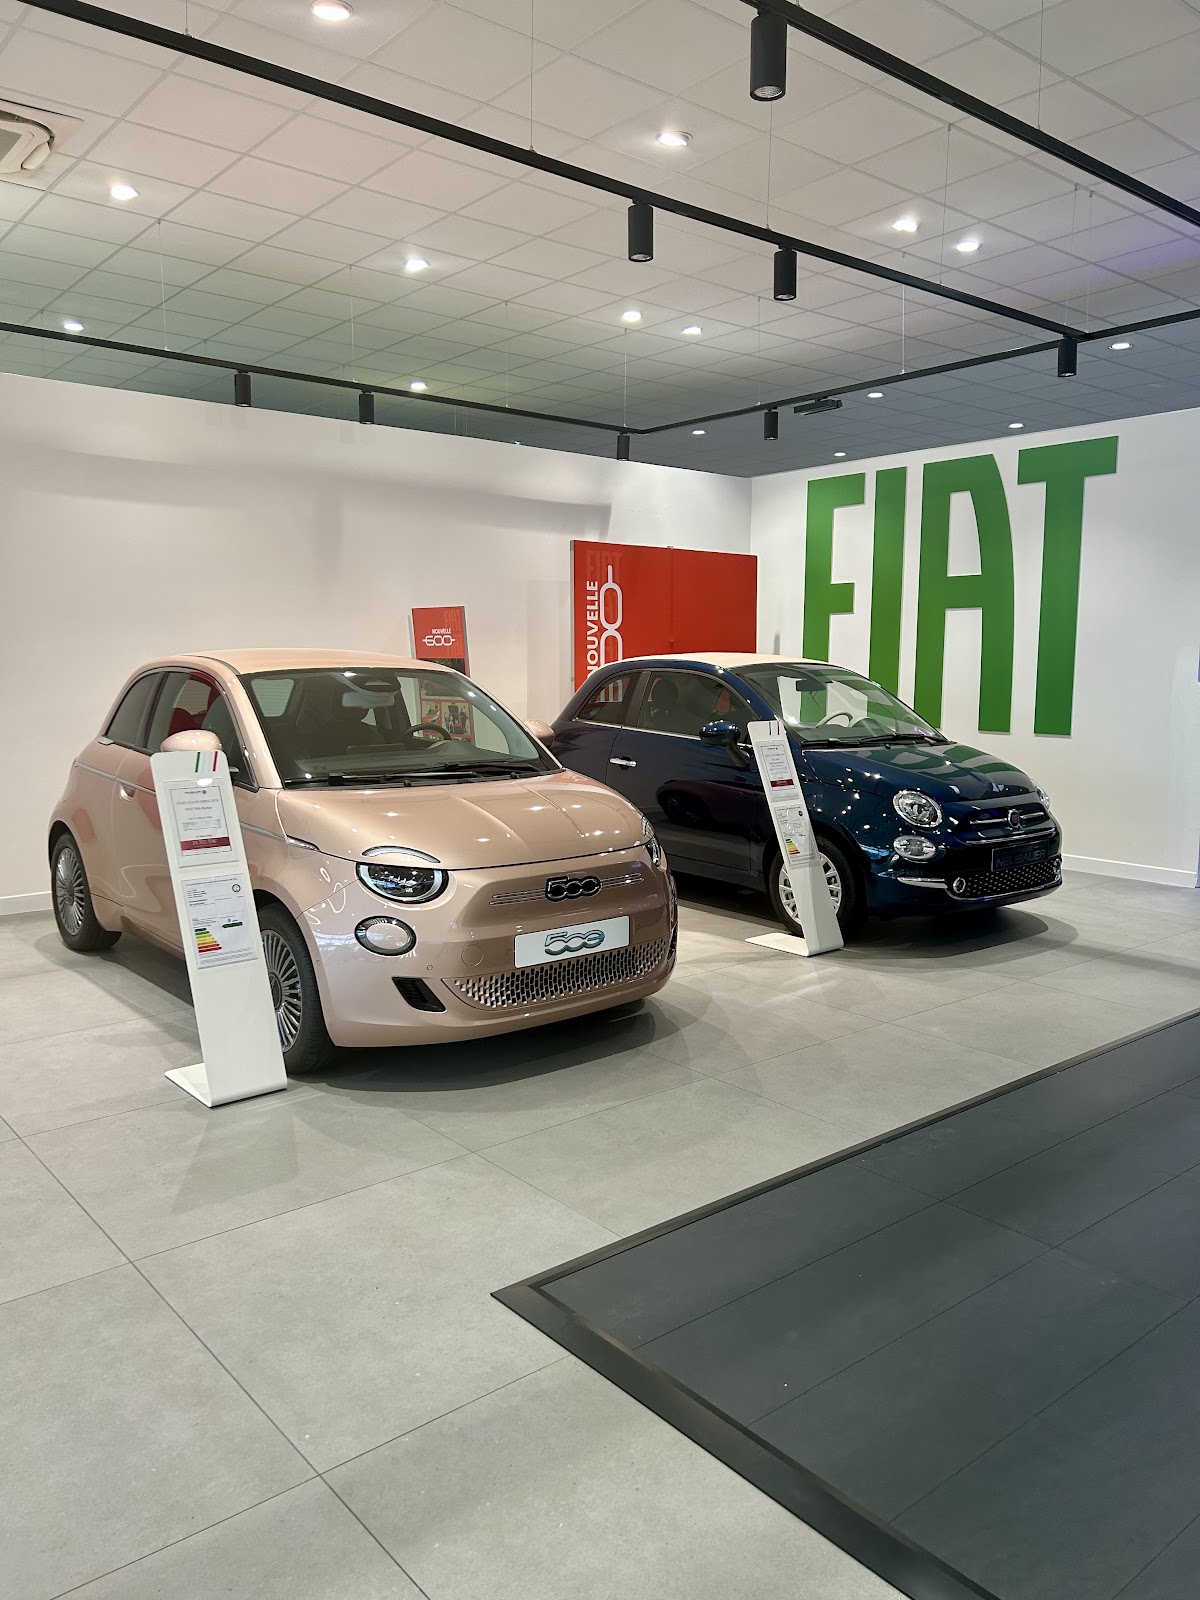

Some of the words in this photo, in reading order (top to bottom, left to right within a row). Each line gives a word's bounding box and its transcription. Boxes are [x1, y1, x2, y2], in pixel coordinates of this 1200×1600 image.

[802, 436, 1119, 737] FIAT
[423, 635, 455, 646] 600
[545, 876, 602, 902] 500
